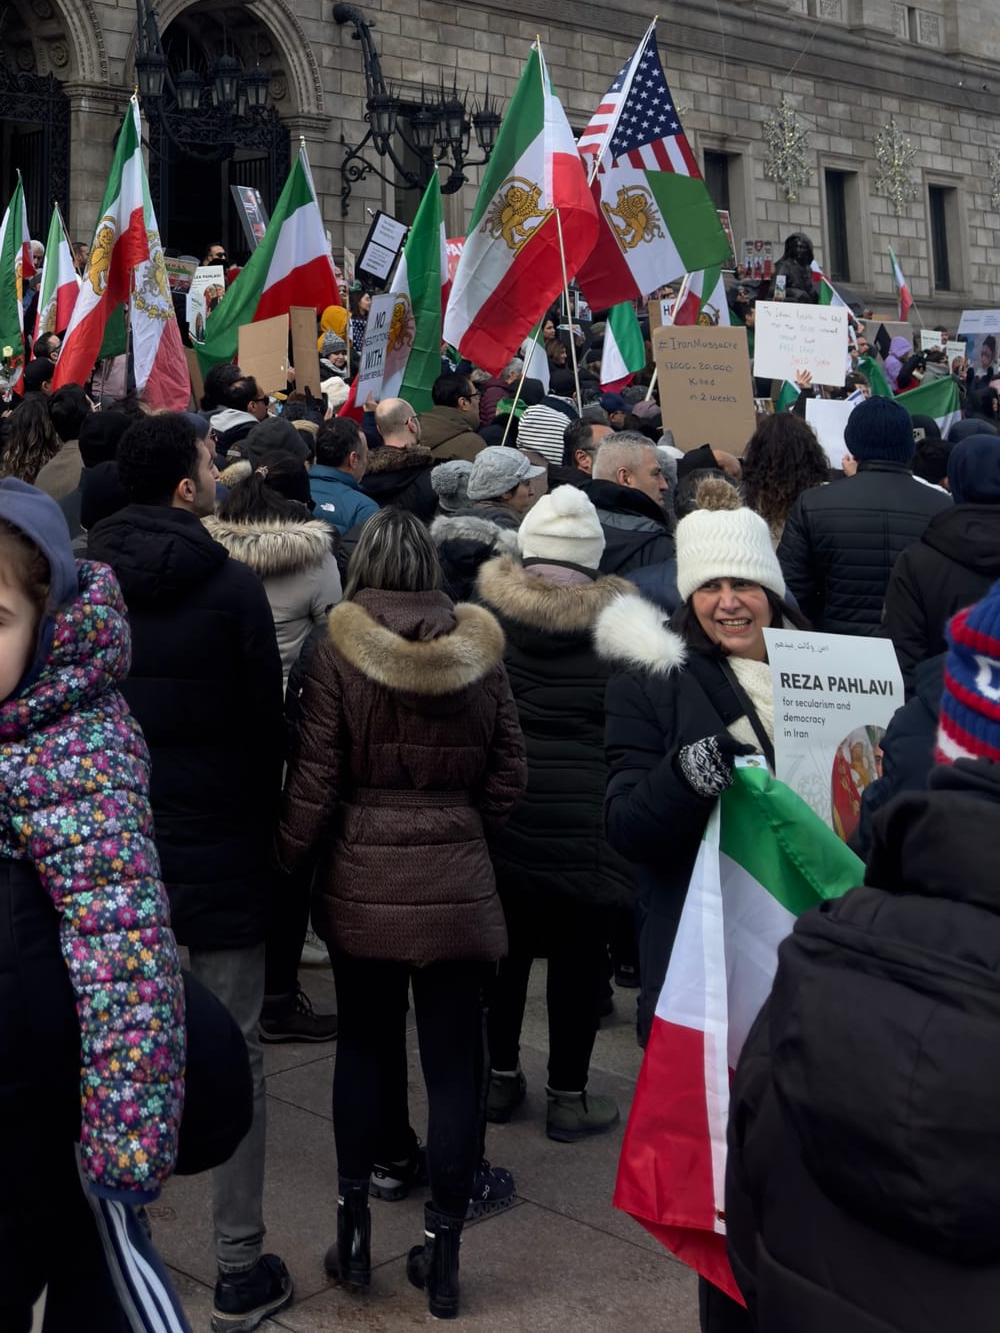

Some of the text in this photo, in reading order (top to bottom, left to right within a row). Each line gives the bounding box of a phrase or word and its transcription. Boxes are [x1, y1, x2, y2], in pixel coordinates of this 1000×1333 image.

[374, 311, 387, 330] NO
[364, 347, 384, 370] WITH
[701, 393, 707, 401] 2
[710, 394, 737, 403] weeks
[780, 672, 894, 696] REZA PAHLAVI
[782, 697, 851, 711] for secularism and
[783, 713, 826, 726] democracy
[783, 728, 809, 738] in Iran
